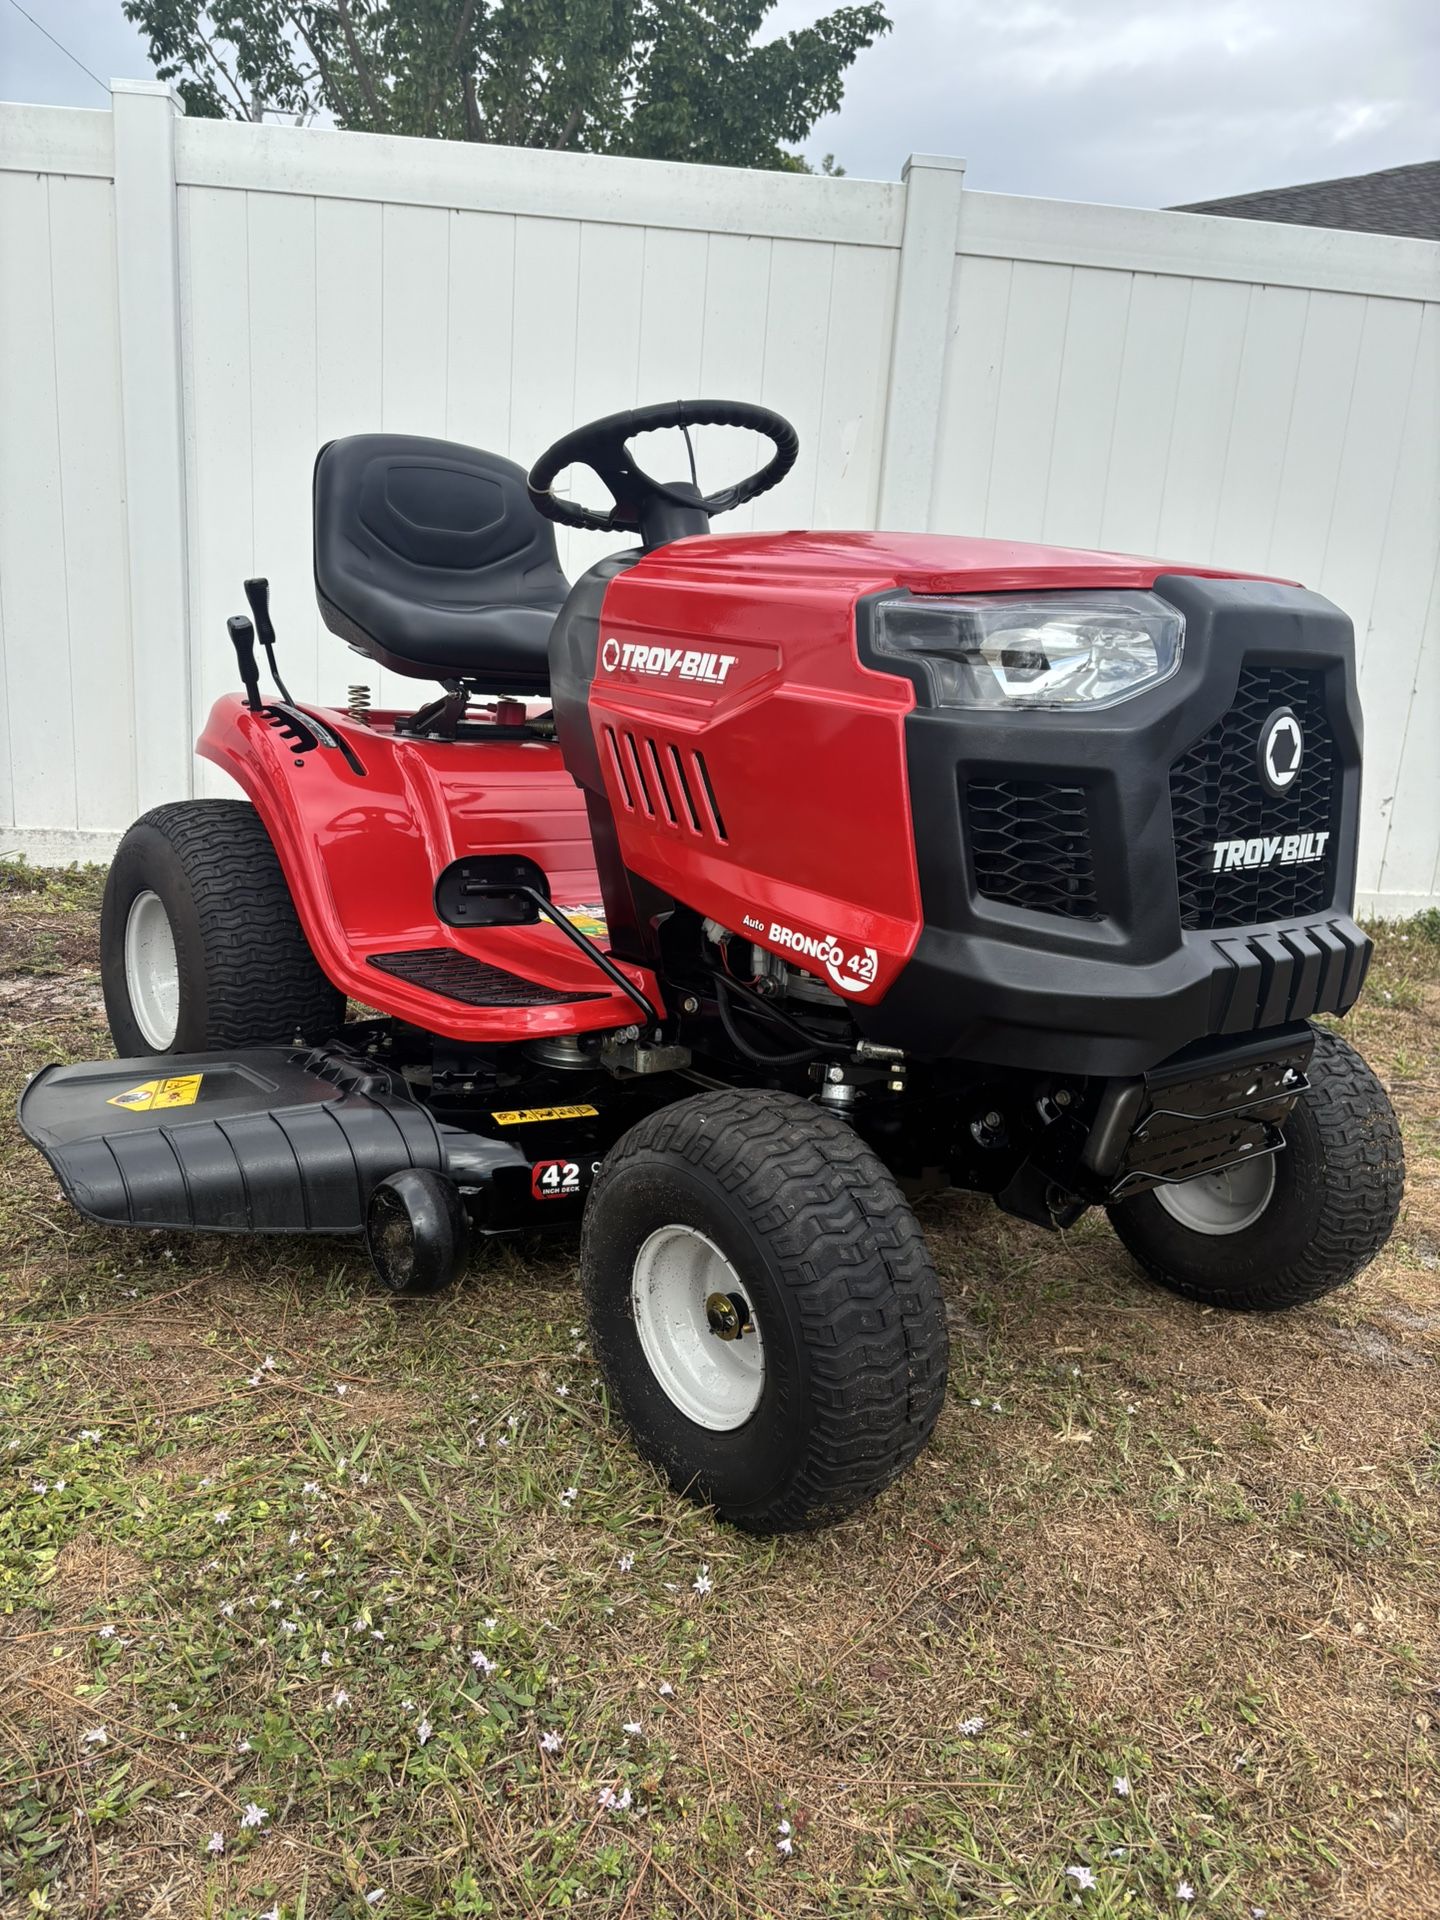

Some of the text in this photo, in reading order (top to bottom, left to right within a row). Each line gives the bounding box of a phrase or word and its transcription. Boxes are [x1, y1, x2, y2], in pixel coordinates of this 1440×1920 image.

[620, 643, 736, 684] TROY-BILT
[1212, 832, 1330, 872] TROY-BILT
[743, 914, 873, 977] Auto BRONCO 42
[542, 1163, 580, 1187] 42
